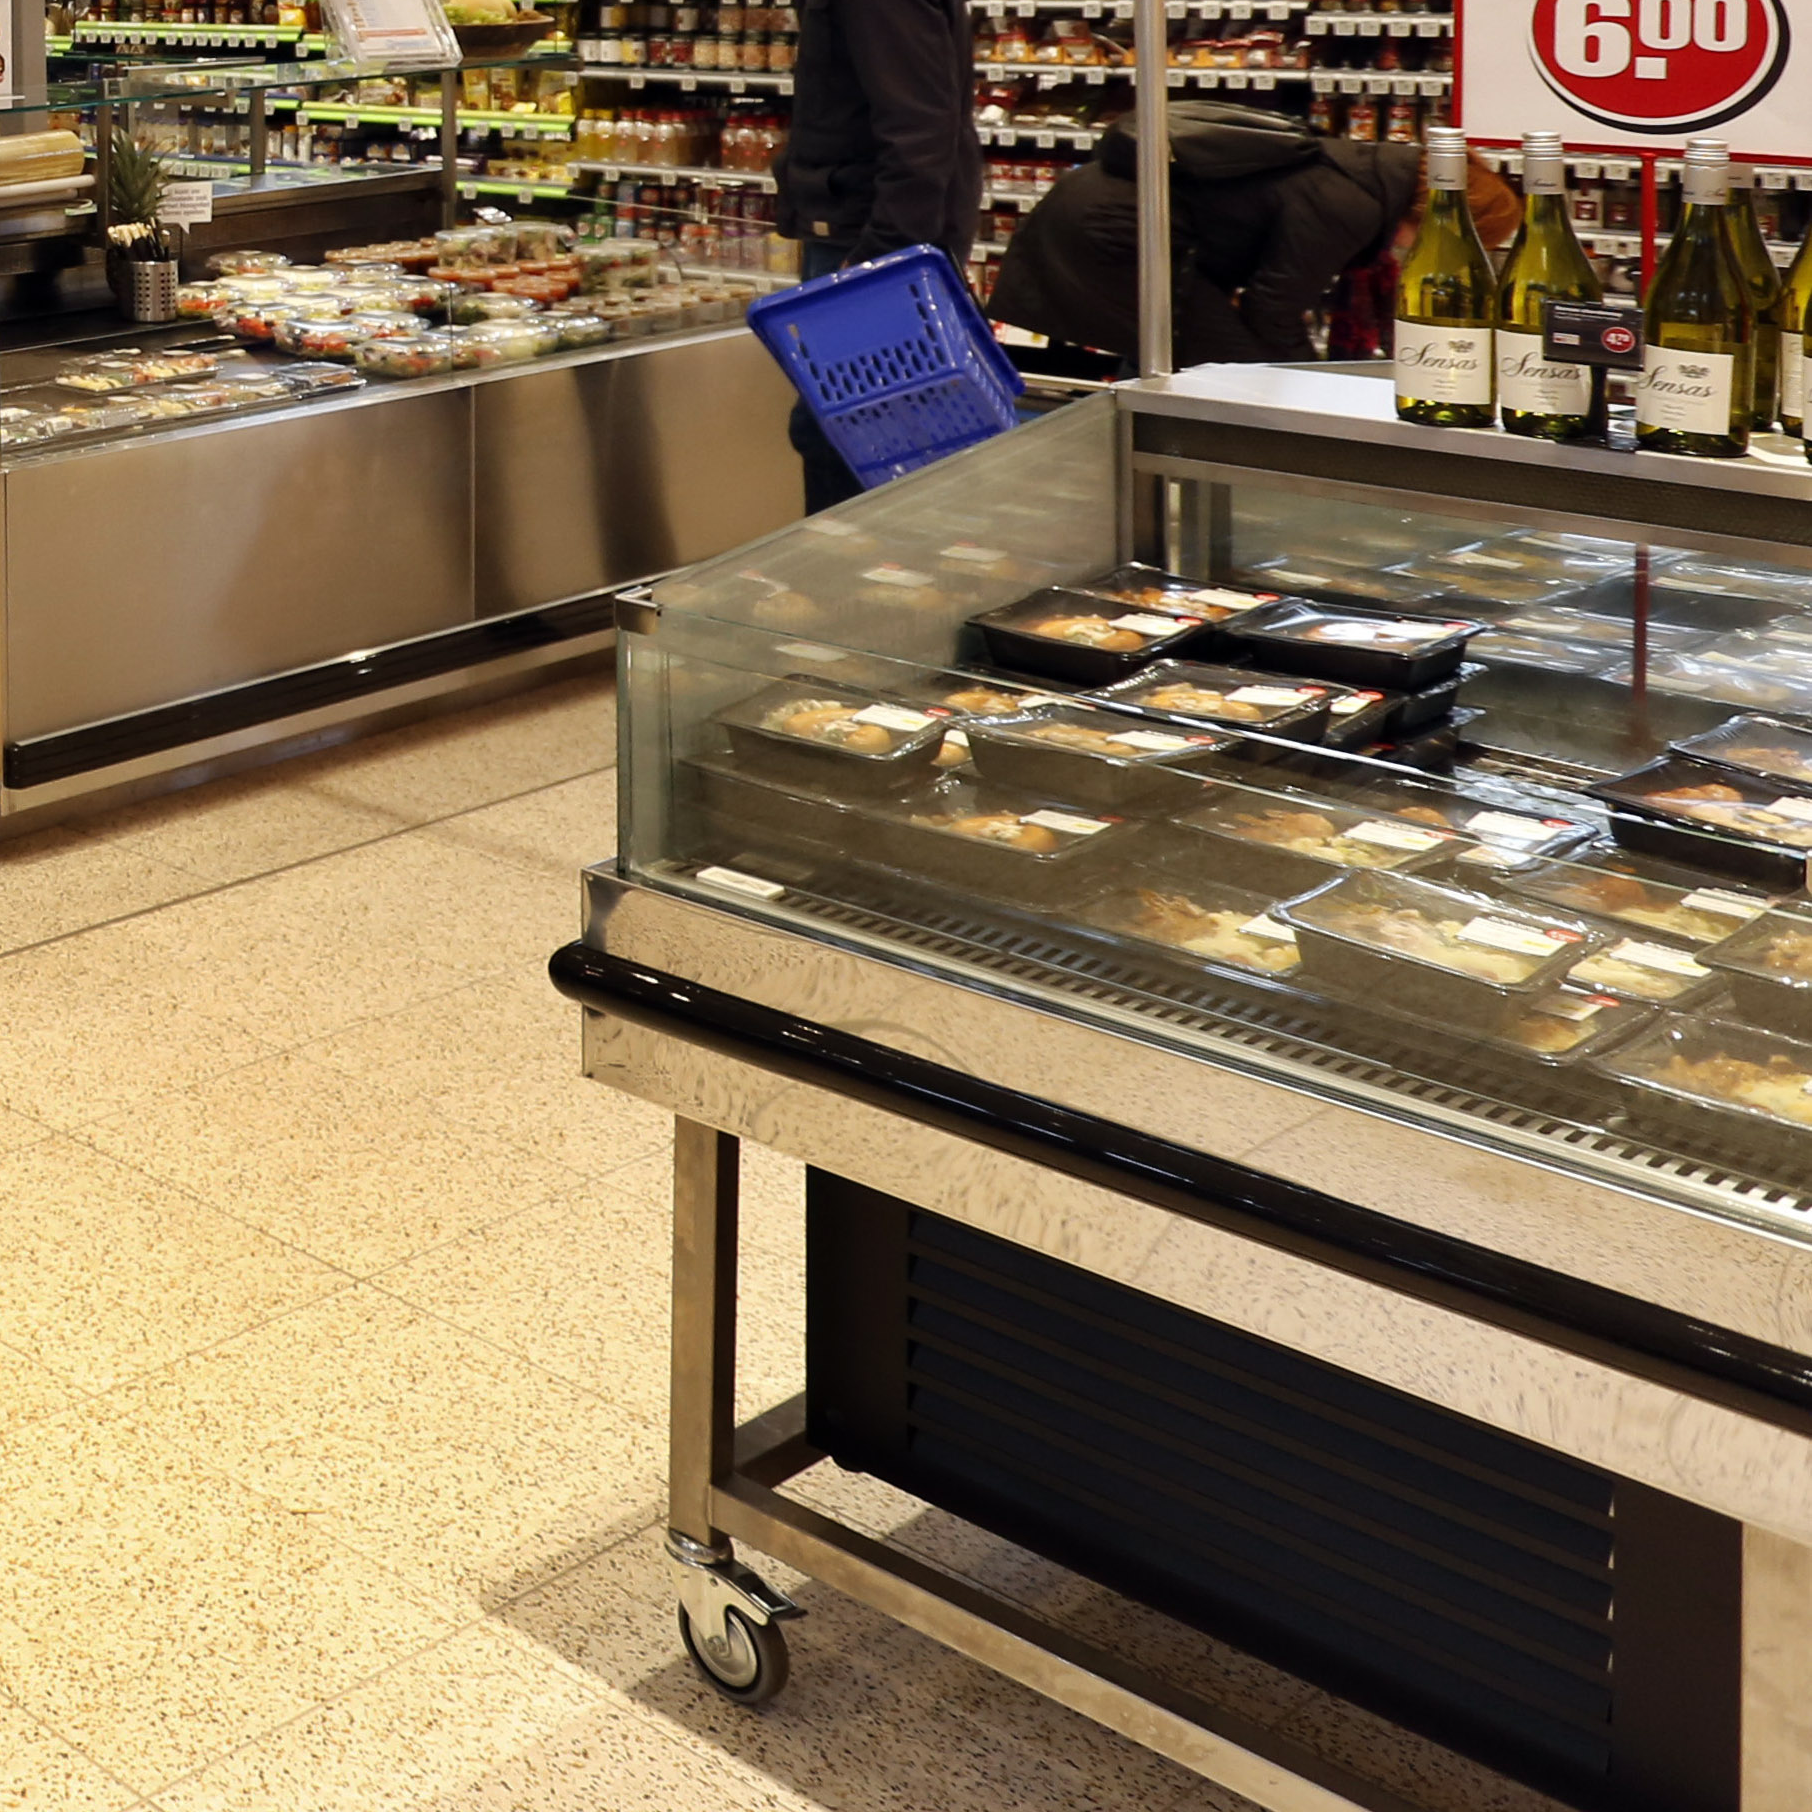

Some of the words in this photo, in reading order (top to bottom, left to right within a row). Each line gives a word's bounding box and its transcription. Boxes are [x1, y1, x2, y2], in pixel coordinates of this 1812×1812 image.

[1398, 343, 1480, 373] Sensas
[1498, 353, 1582, 383] Sensas
[1634, 364, 1717, 400] Sensas
